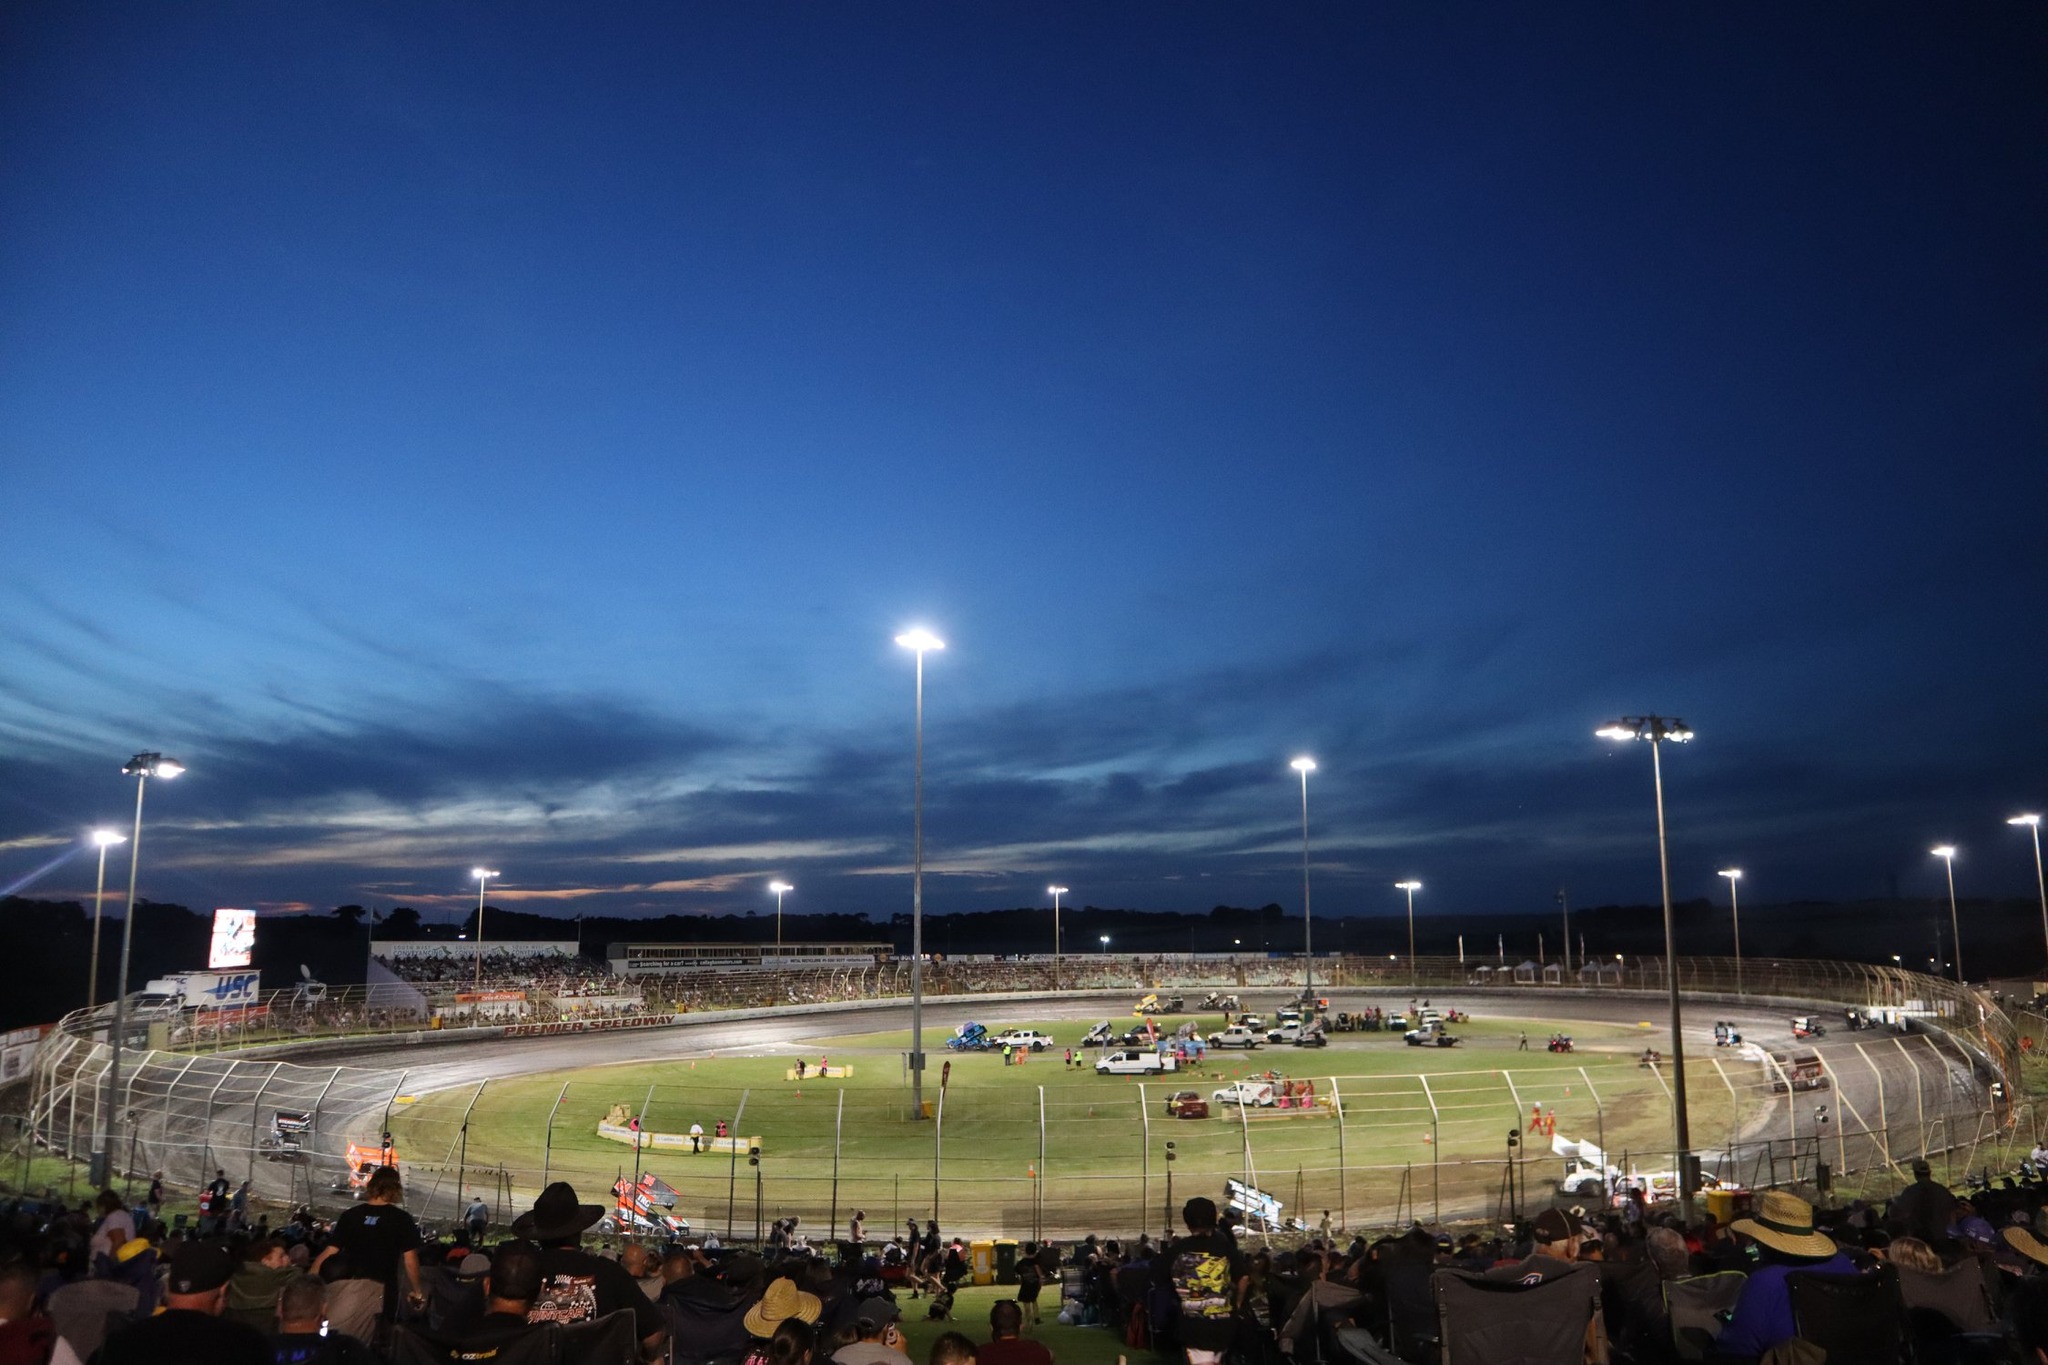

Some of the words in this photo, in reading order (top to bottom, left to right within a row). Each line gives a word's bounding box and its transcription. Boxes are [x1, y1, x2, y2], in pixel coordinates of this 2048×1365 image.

[214, 975, 259, 1000] USC
[504, 1022, 584, 1037] PREMIER
[590, 1015, 676, 1031] SPEEDWAY
